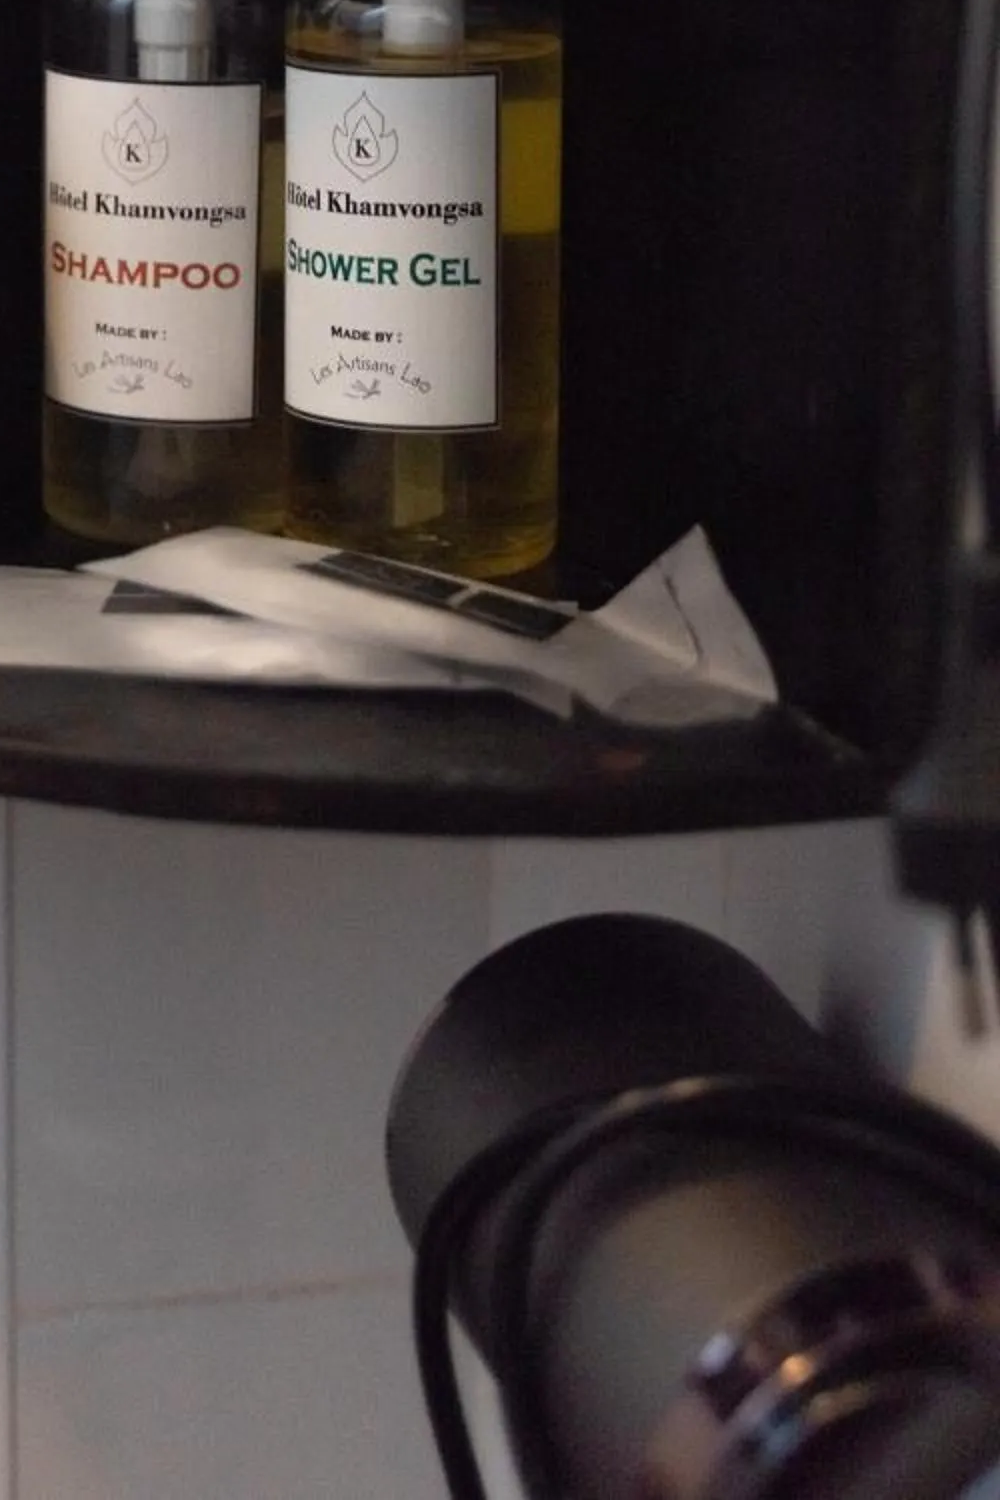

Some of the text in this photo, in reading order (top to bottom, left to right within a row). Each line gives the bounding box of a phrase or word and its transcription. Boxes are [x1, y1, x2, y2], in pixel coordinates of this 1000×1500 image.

[126, 143, 141, 164] K
[355, 137, 372, 159] K
[95, 193, 247, 228] Khamvongsa
[287, 180, 484, 225] Hôtel Khamvongsa
[51, 240, 241, 290] SHAMPOO
[287, 236, 481, 287] SHOWER GEL
[95, 322, 137, 339] MADE
[330, 325, 371, 342] MADE
[100, 349, 160, 373] Artisans
[336, 353, 397, 376] Artisans
[401, 361, 432, 395] Lao
